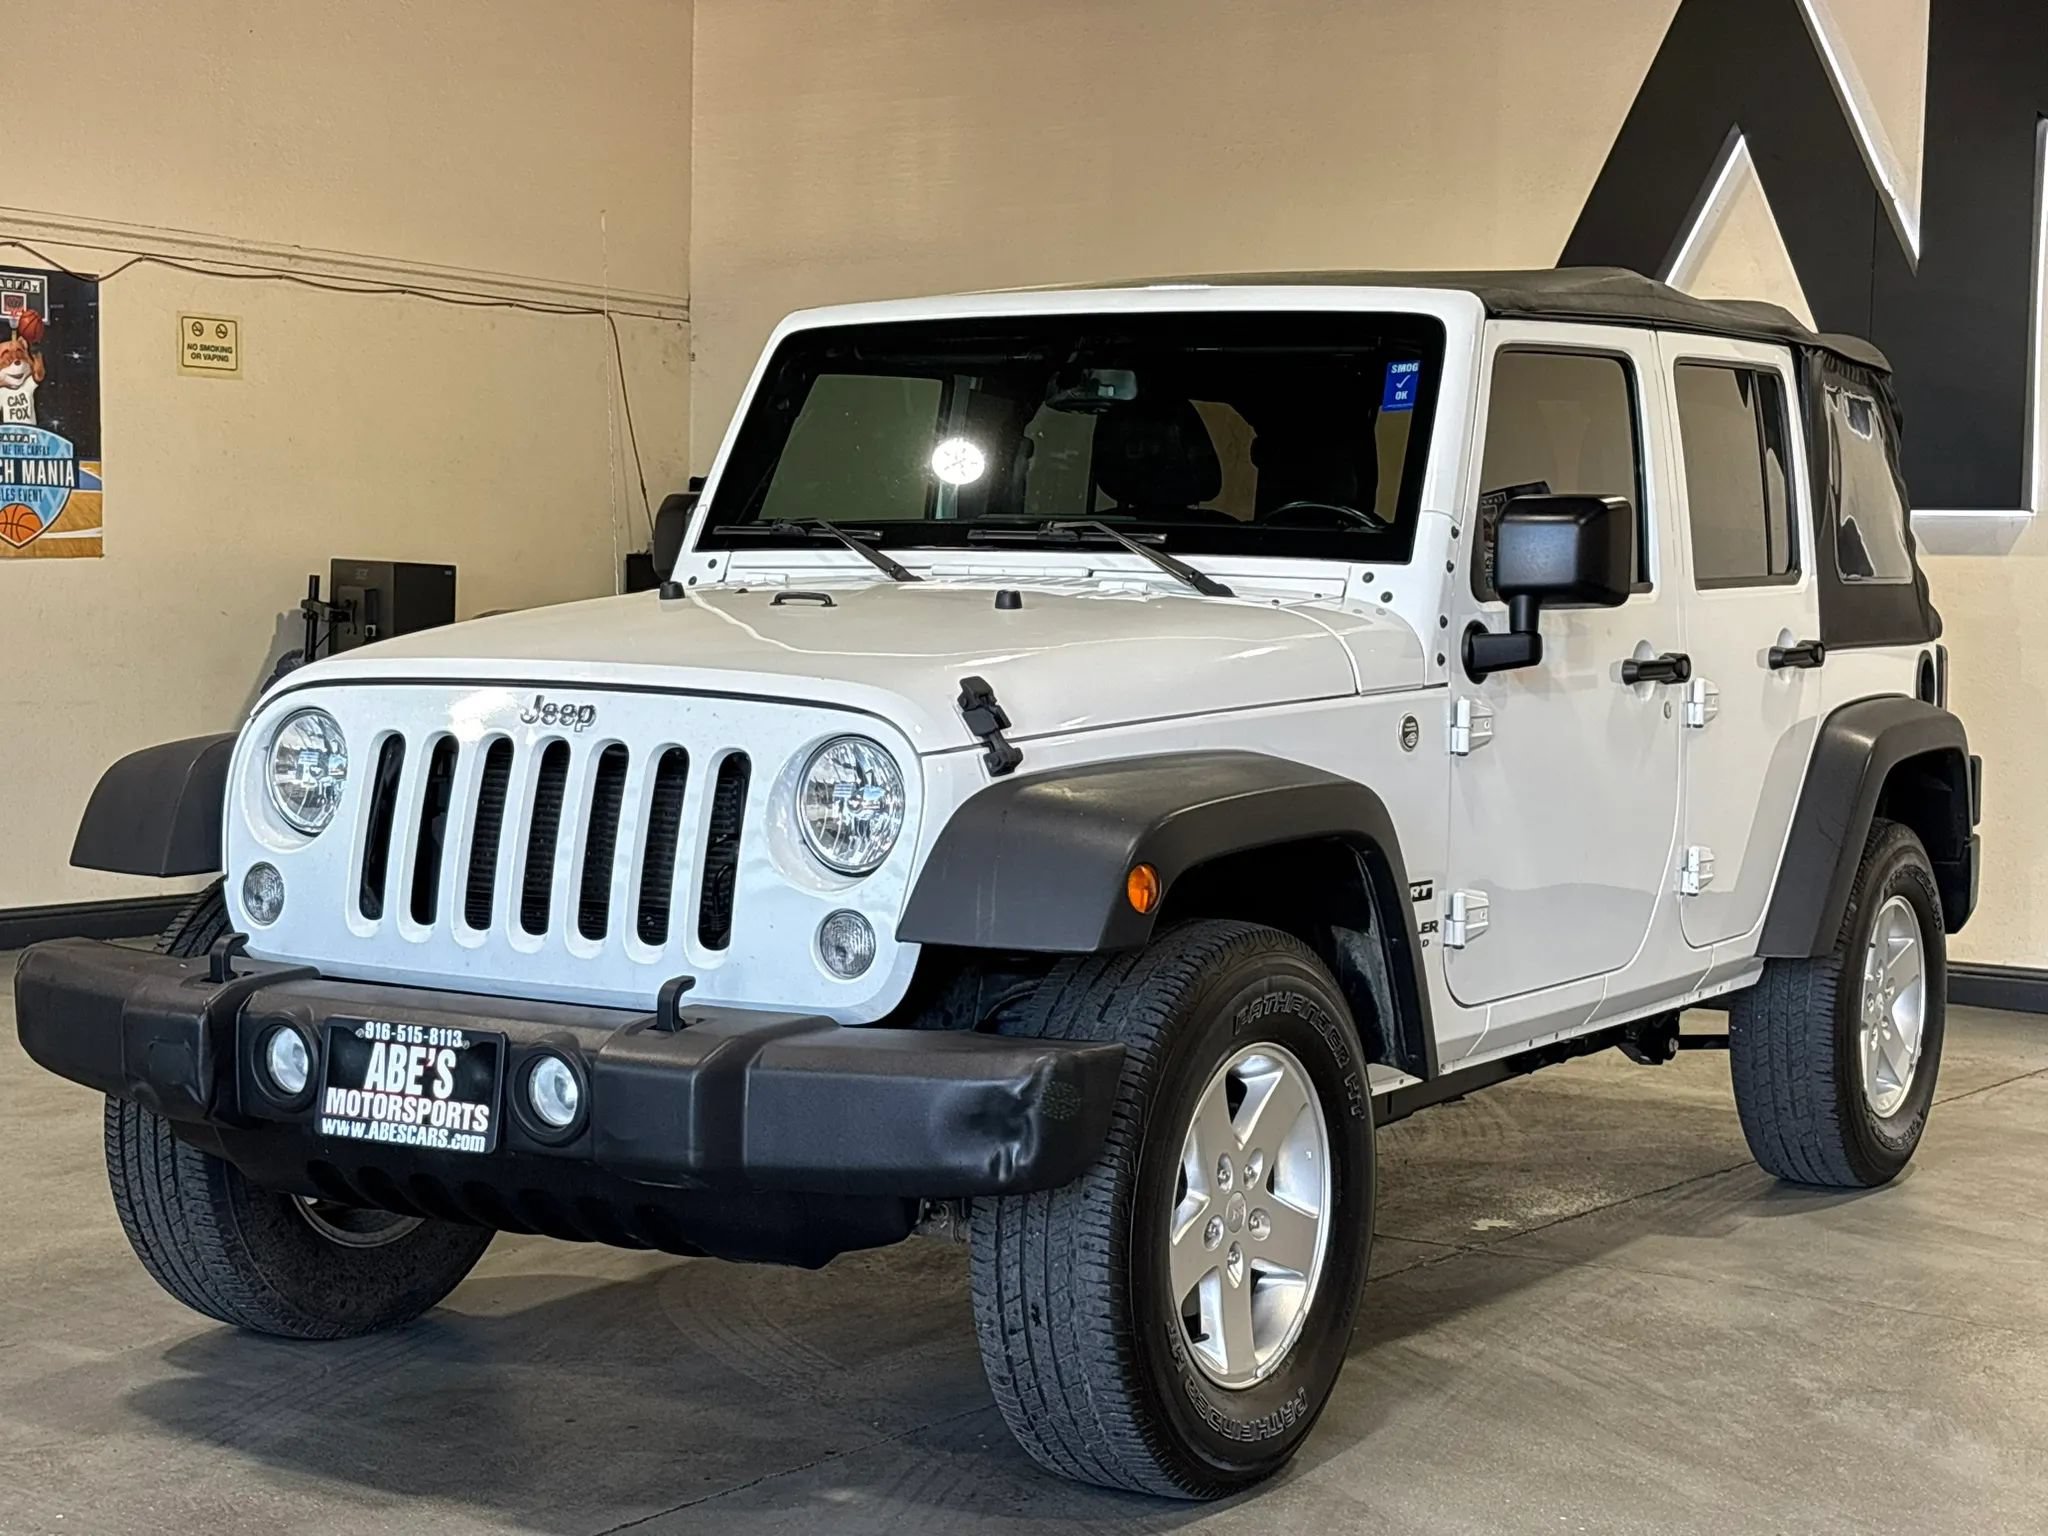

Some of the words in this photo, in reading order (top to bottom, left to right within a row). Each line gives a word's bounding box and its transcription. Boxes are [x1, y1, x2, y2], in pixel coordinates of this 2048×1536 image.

[187, 343, 198, 351] NO
[199, 344, 233, 354] SMOKING
[191, 352, 202, 360] OR
[203, 353, 229, 362] VAPING
[1391, 363, 1419, 374] SMOG
[7, 393, 28, 407] CAR
[1395, 391, 1408, 400] OK
[9, 406, 30, 420] FOX
[22, 460, 75, 487] MANIA
[18, 487, 42, 502] EVENT
[520, 695, 596, 733] Jeep
[365, 1021, 463, 1048] 916-515-8113
[363, 1042, 457, 1099] ABE'S
[325, 1087, 490, 1132] MOTORSPORTS
[1184, 1375, 1308, 1442] PATHFINDER
